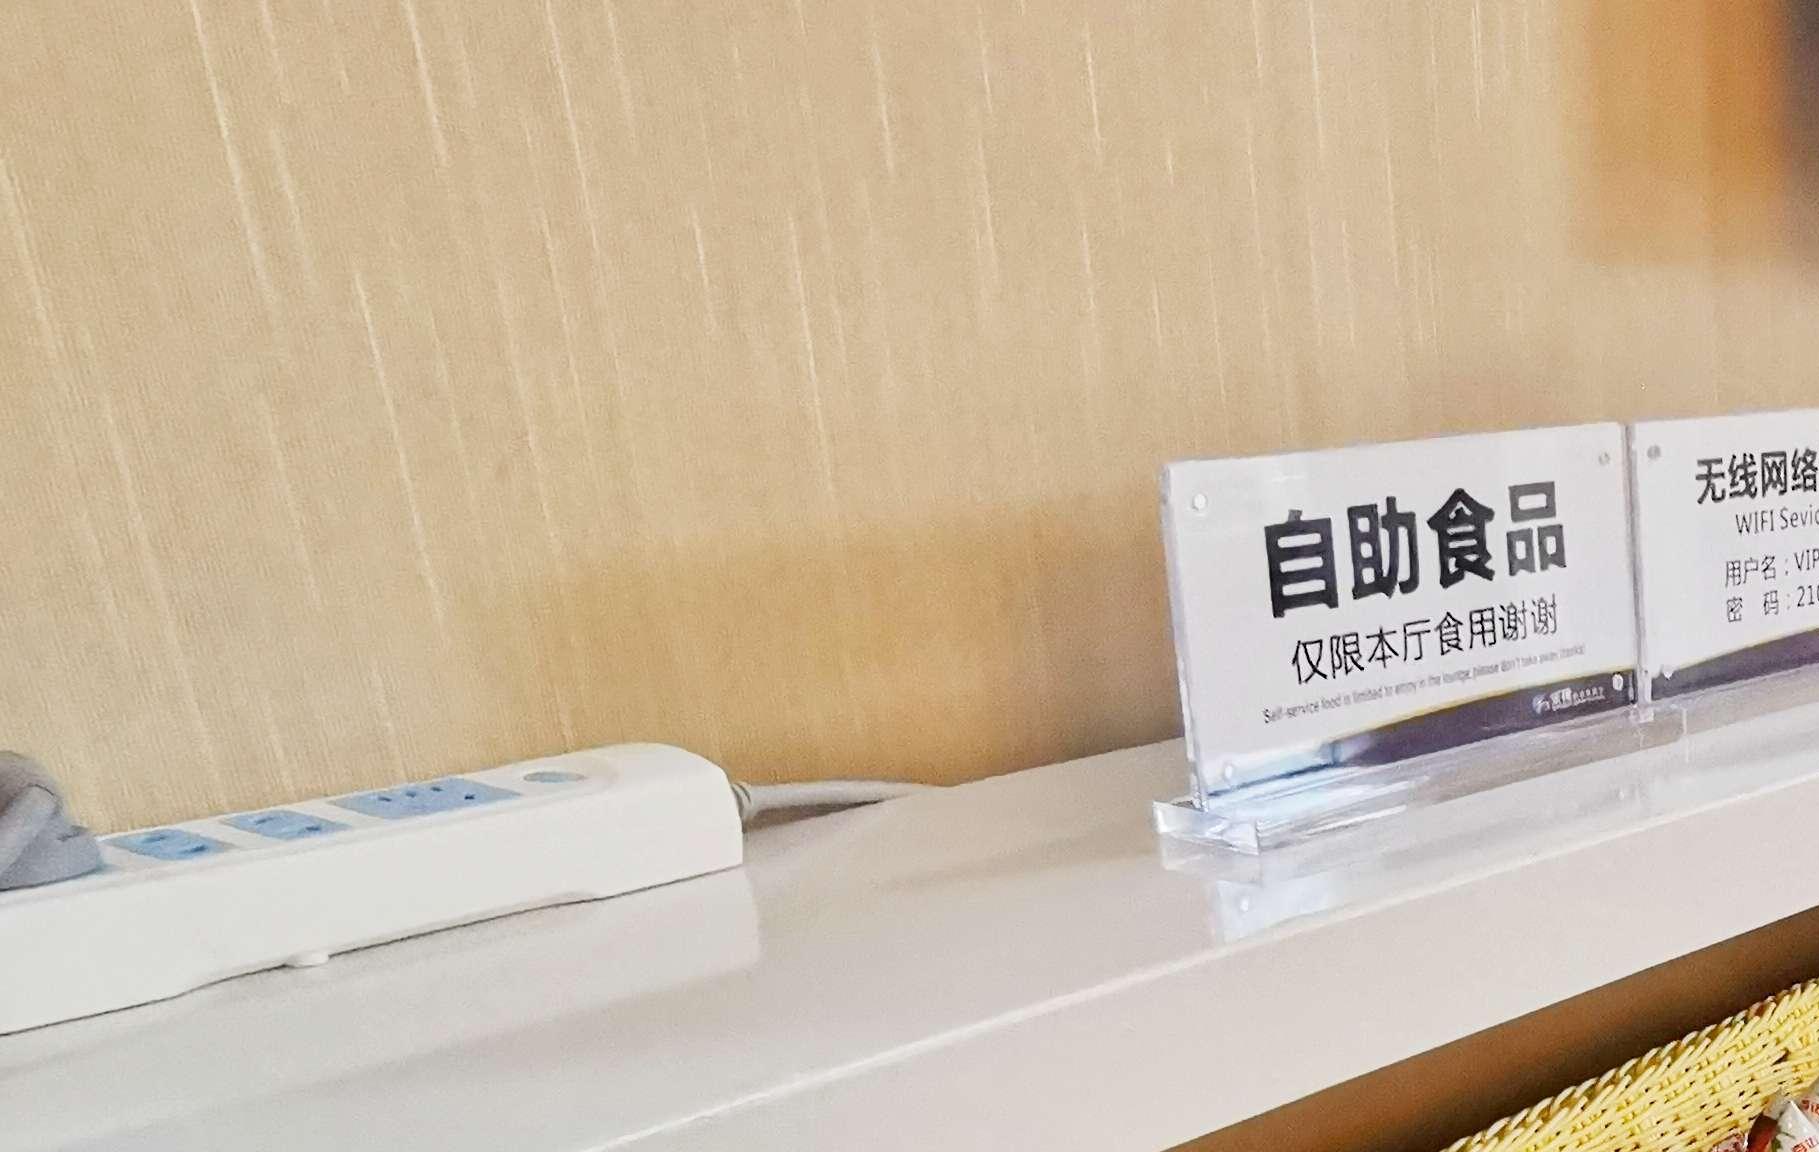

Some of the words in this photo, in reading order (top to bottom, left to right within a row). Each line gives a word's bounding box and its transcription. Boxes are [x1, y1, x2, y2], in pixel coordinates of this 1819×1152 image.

[1263, 480, 1567, 619] 自助食品
[1736, 510, 1775, 536] WIFI
[1291, 592, 1558, 684] 仅限本厅食用谢谢
